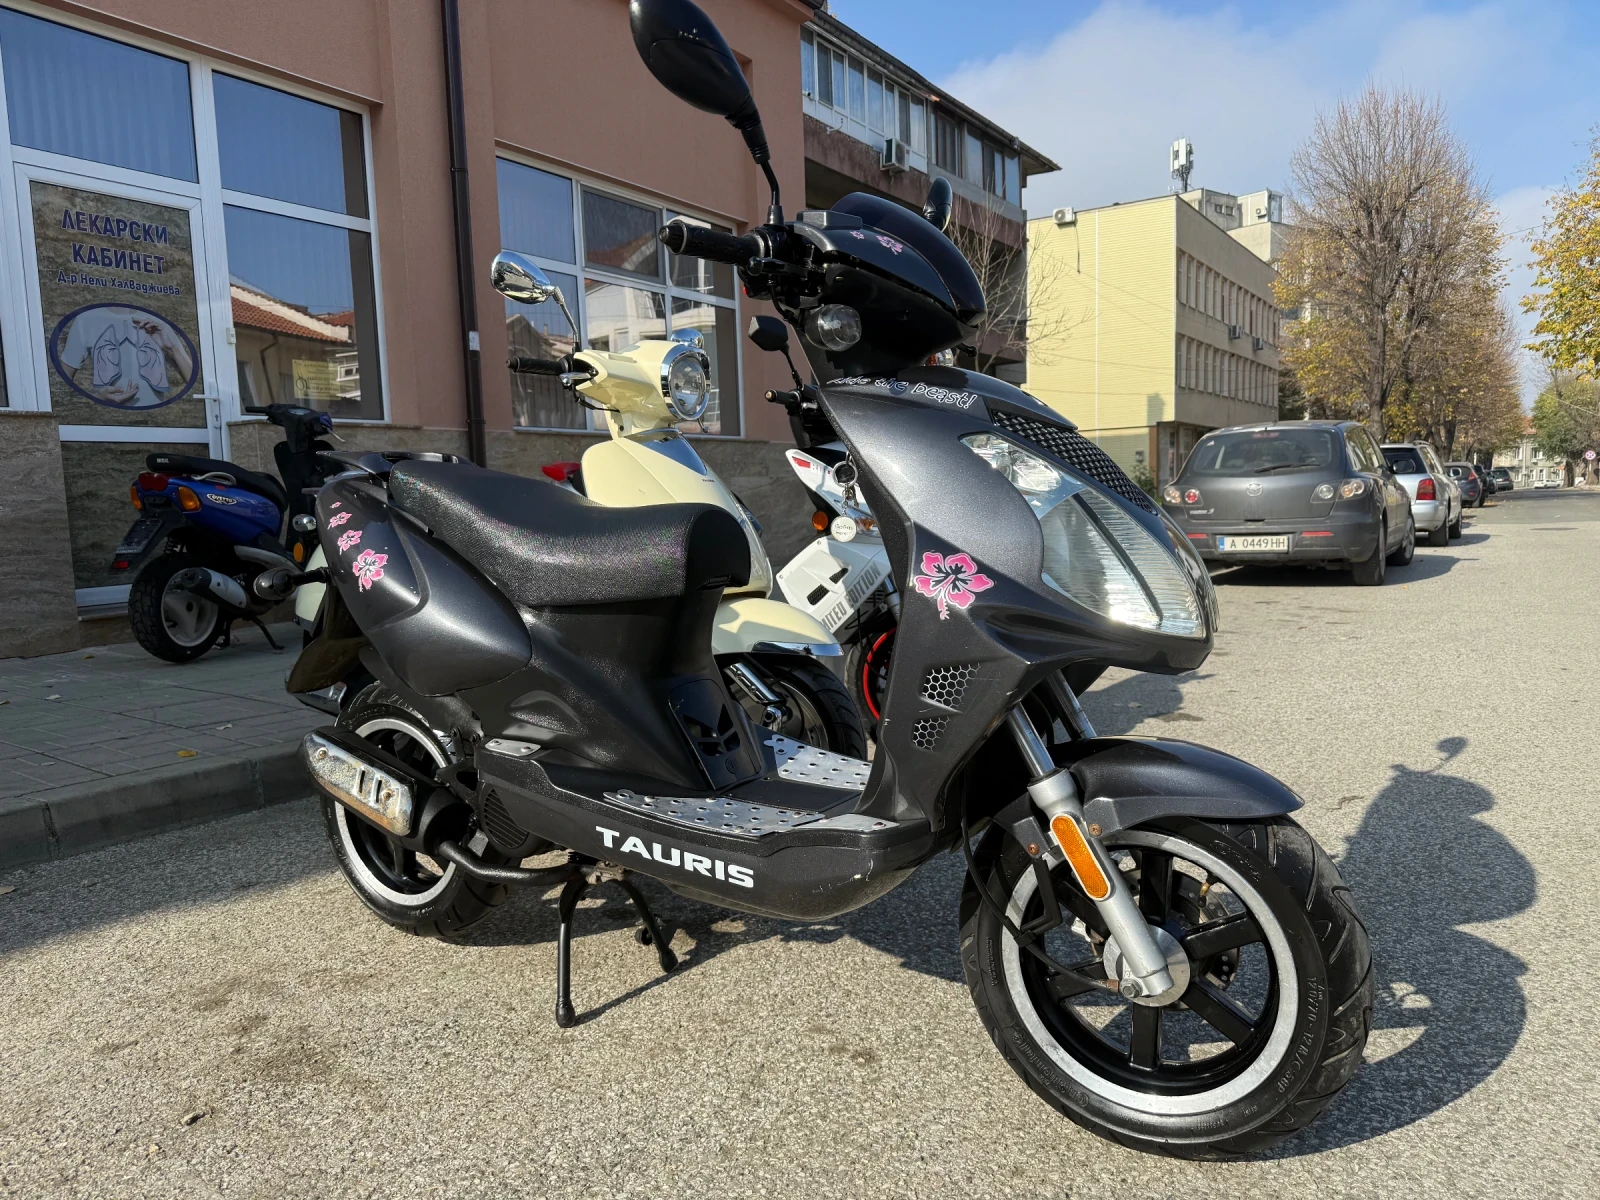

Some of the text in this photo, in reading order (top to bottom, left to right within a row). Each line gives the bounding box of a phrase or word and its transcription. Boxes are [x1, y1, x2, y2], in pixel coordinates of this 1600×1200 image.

[62, 208, 168, 244] ЛЕКАРСКИ
[72, 242, 165, 274] КАБИНЕТ
[57, 269, 180, 296] Д-р Нели Халваджиева
[911, 382, 978, 409] beast!
[1230, 539, 1237, 549] A
[844, 561, 882, 609] EDITION
[595, 825, 754, 888] TAURIS
